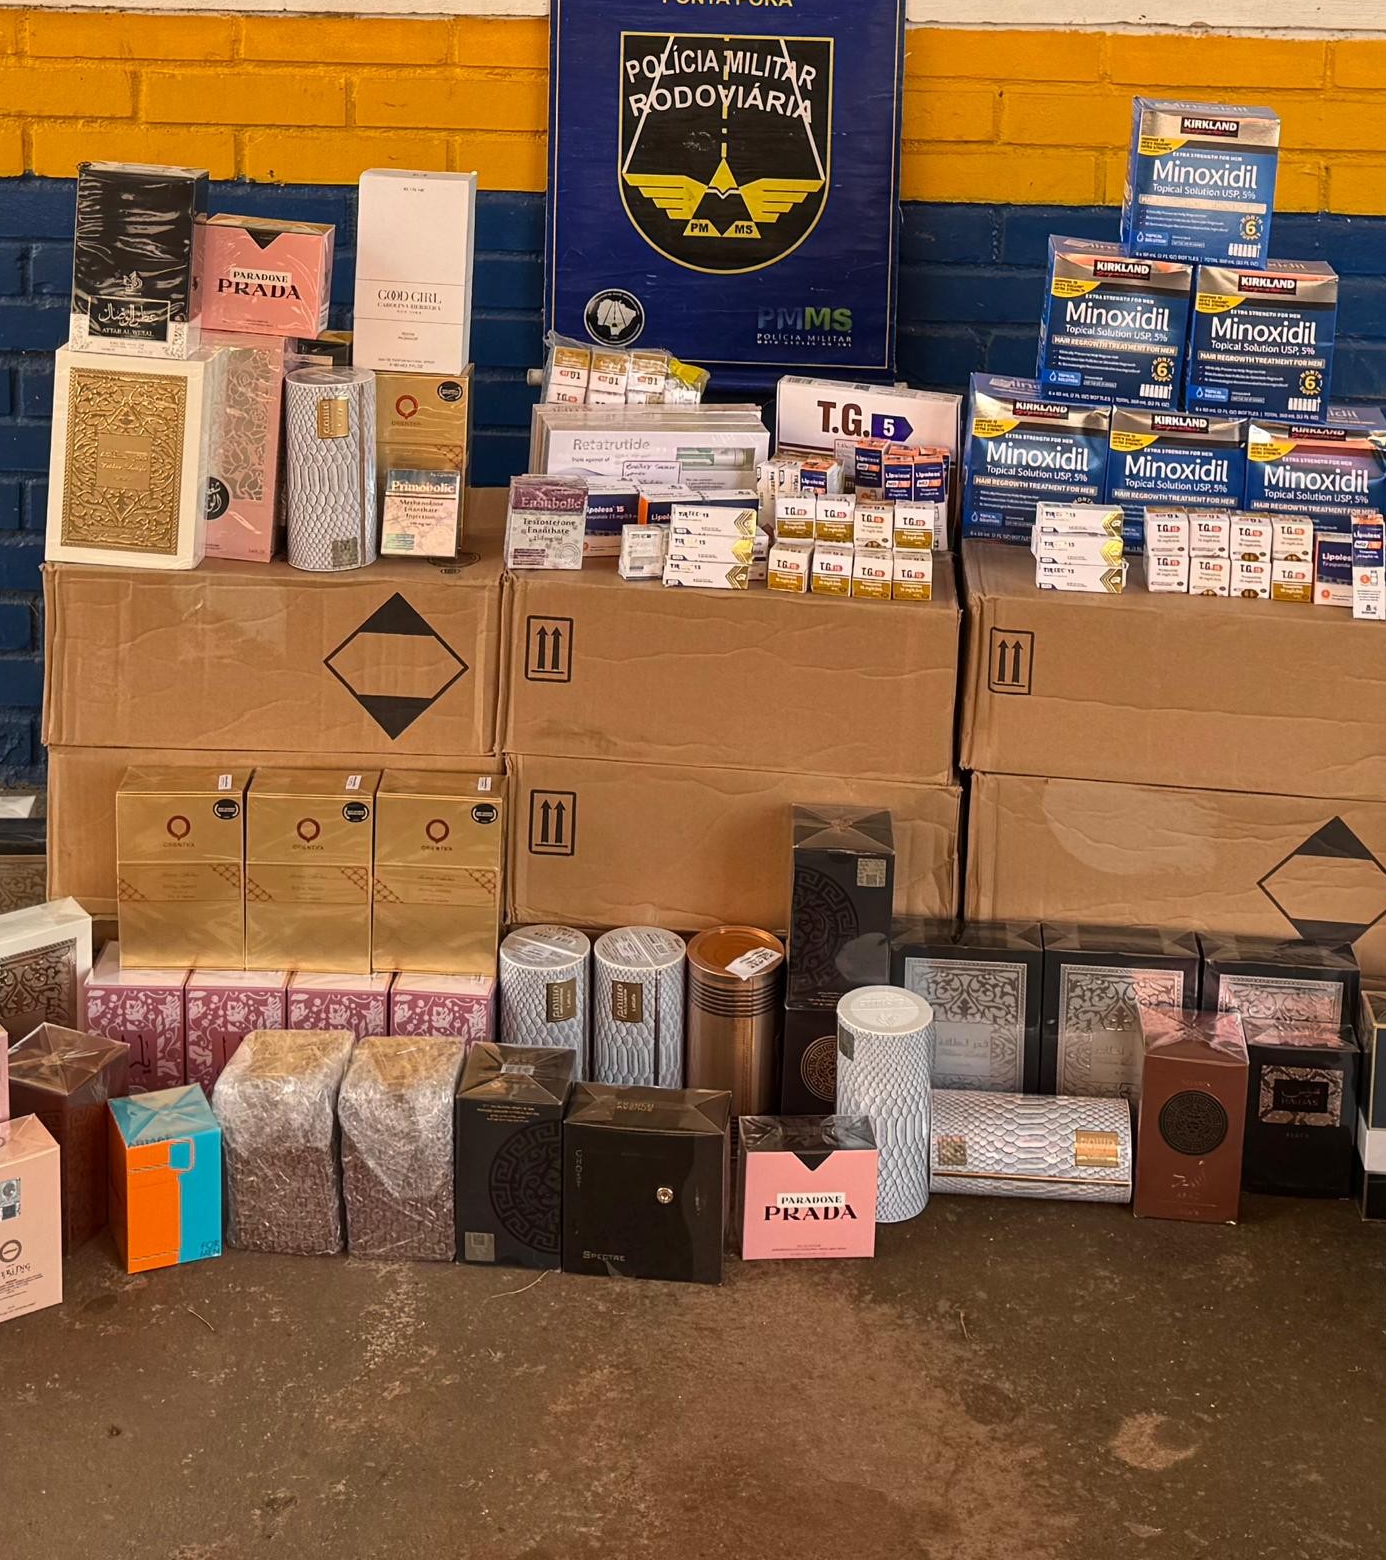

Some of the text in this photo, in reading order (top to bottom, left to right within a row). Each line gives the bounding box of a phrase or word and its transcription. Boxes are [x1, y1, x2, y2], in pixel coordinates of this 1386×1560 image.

[625, 45, 817, 91] POLÍCIA MILITAR
[629, 82, 814, 124] RODOVIÁRIA
[1184, 119, 1237, 132] KIRKLAND
[1153, 160, 1257, 188] Minoxidil
[1153, 184, 1183, 196] Topical
[1185, 186, 1220, 197] Solution
[1243, 191, 1256, 199] 5%
[690, 221, 753, 235] PM MS
[1246, 221, 1256, 235] 6
[1097, 261, 1149, 274] KIRKLAND
[233, 271, 288, 283] PARADOXE
[1241, 277, 1295, 288] KIRKLAND
[218, 278, 301, 300] PRADA
[378, 289, 442, 304] GOOD GIRL
[757, 306, 853, 332] PMMS
[1066, 301, 1169, 331] Minoxidil
[757, 333, 852, 342] POLÍCIA MILITAR
[1066, 325, 1095, 337] Topical
[1098, 327, 1132, 338] Solution
[1154, 332, 1167, 342] 5%
[1211, 317, 1315, 344] Minoxidil
[1211, 340, 1241, 352] Topical
[1244, 343, 1279, 352] Solution
[1302, 347, 1315, 355] 5%
[1157, 363, 1167, 376] 6
[1305, 376, 1315, 389] 6
[1016, 402, 1067, 413] KIRKLAND
[817, 400, 895, 438] T.G. 5
[1155, 416, 1207, 428] KIRKLAND
[573, 438, 650, 450] Retatrutide
[987, 441, 1088, 471] Minoxidil
[987, 465, 1016, 477] Topical
[1019, 468, 1052, 479] Solution
[1074, 473, 1087, 482] 5%
[1125, 455, 1228, 482] Minoxidil
[391, 480, 455, 493] Primobolic
[1125, 478, 1154, 490] Topical
[1157, 481, 1191, 490] Solution
[1214, 484, 1227, 493] 5%
[1264, 465, 1369, 493] Minoxidil
[1264, 489, 1294, 501] Topical
[1297, 491, 1332, 501] Solution
[1355, 494, 1368, 503] 5%
[586, 505, 613, 513] ipoless
[523, 518, 576, 526] Testosterone
[781, 1195, 843, 1205] PARADOXE
[764, 1204, 857, 1221] PRADA
